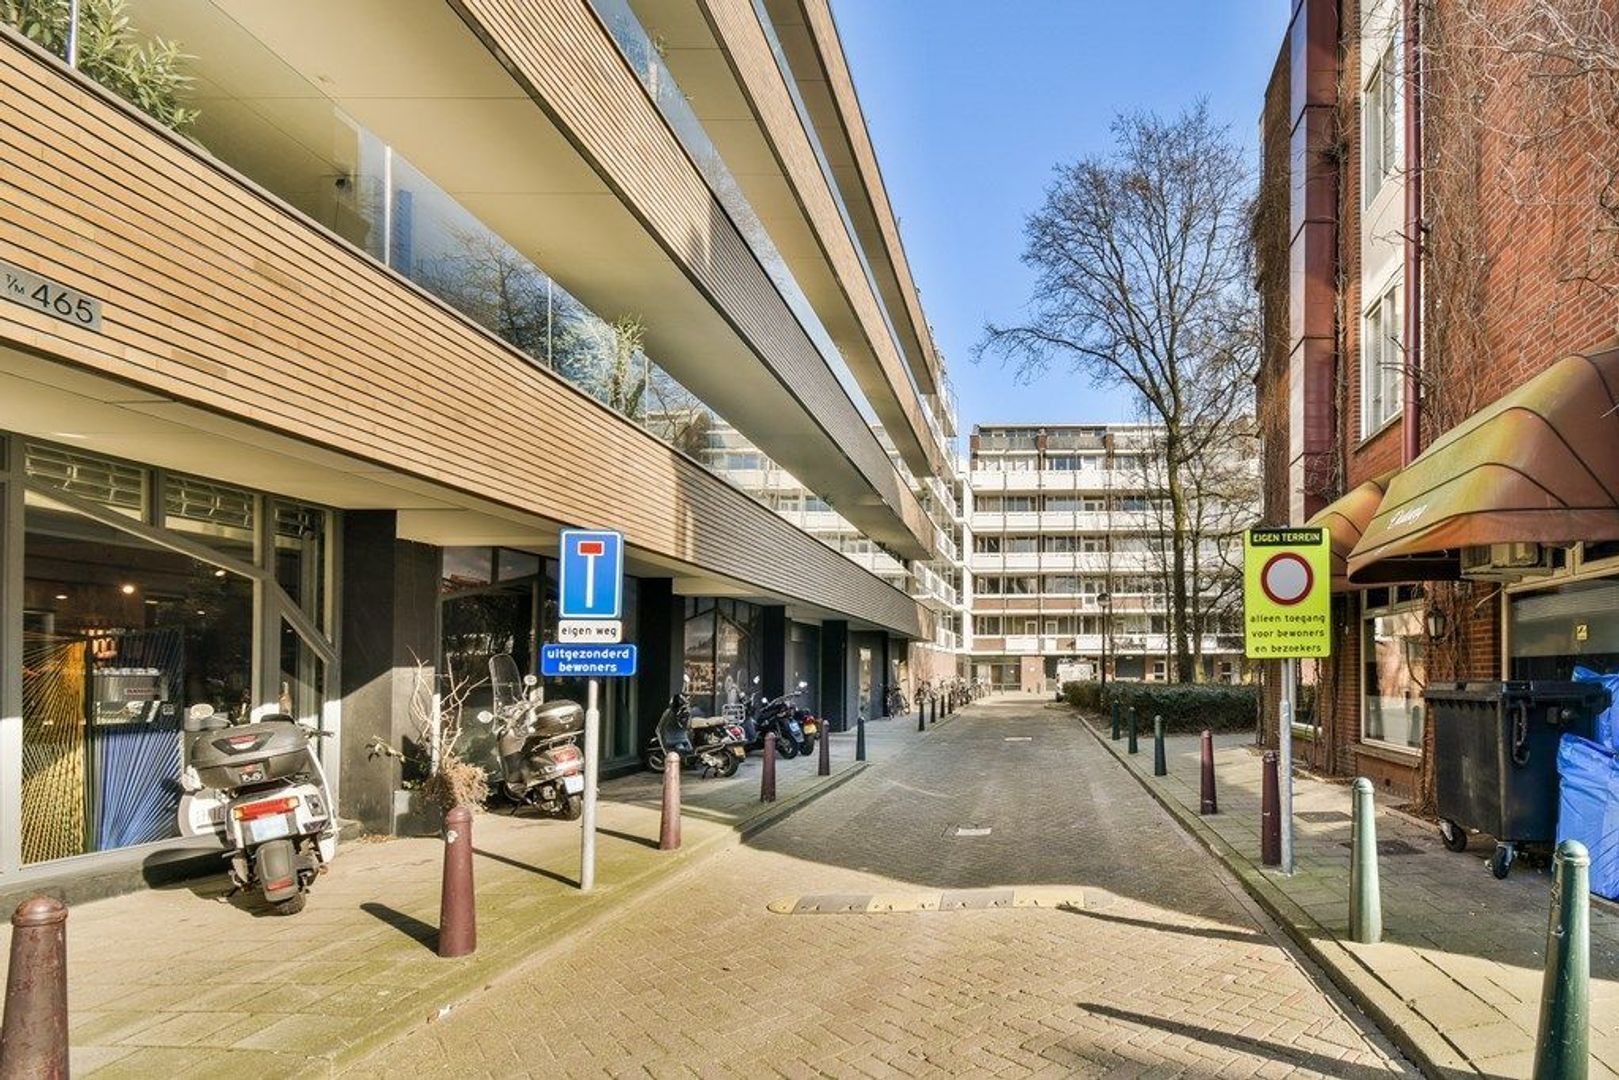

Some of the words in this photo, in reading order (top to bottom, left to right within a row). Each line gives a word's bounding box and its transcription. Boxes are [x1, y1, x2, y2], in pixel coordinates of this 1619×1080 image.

[31, 284, 93, 323] 465
[1252, 533, 1280, 542] EIGEN
[1282, 532, 1320, 542] TERREIN
[1250, 614, 1281, 622] alleen
[1285, 614, 1325, 623] toegang
[561, 626, 592, 637] eigen
[596, 626, 617, 636] weg
[1251, 629, 1273, 637] voor
[1277, 628, 1325, 637] bewoners
[1271, 644, 1321, 653] bezoekers
[547, 649, 629, 660] uitgezonderd
[558, 662, 617, 672] bewoners
